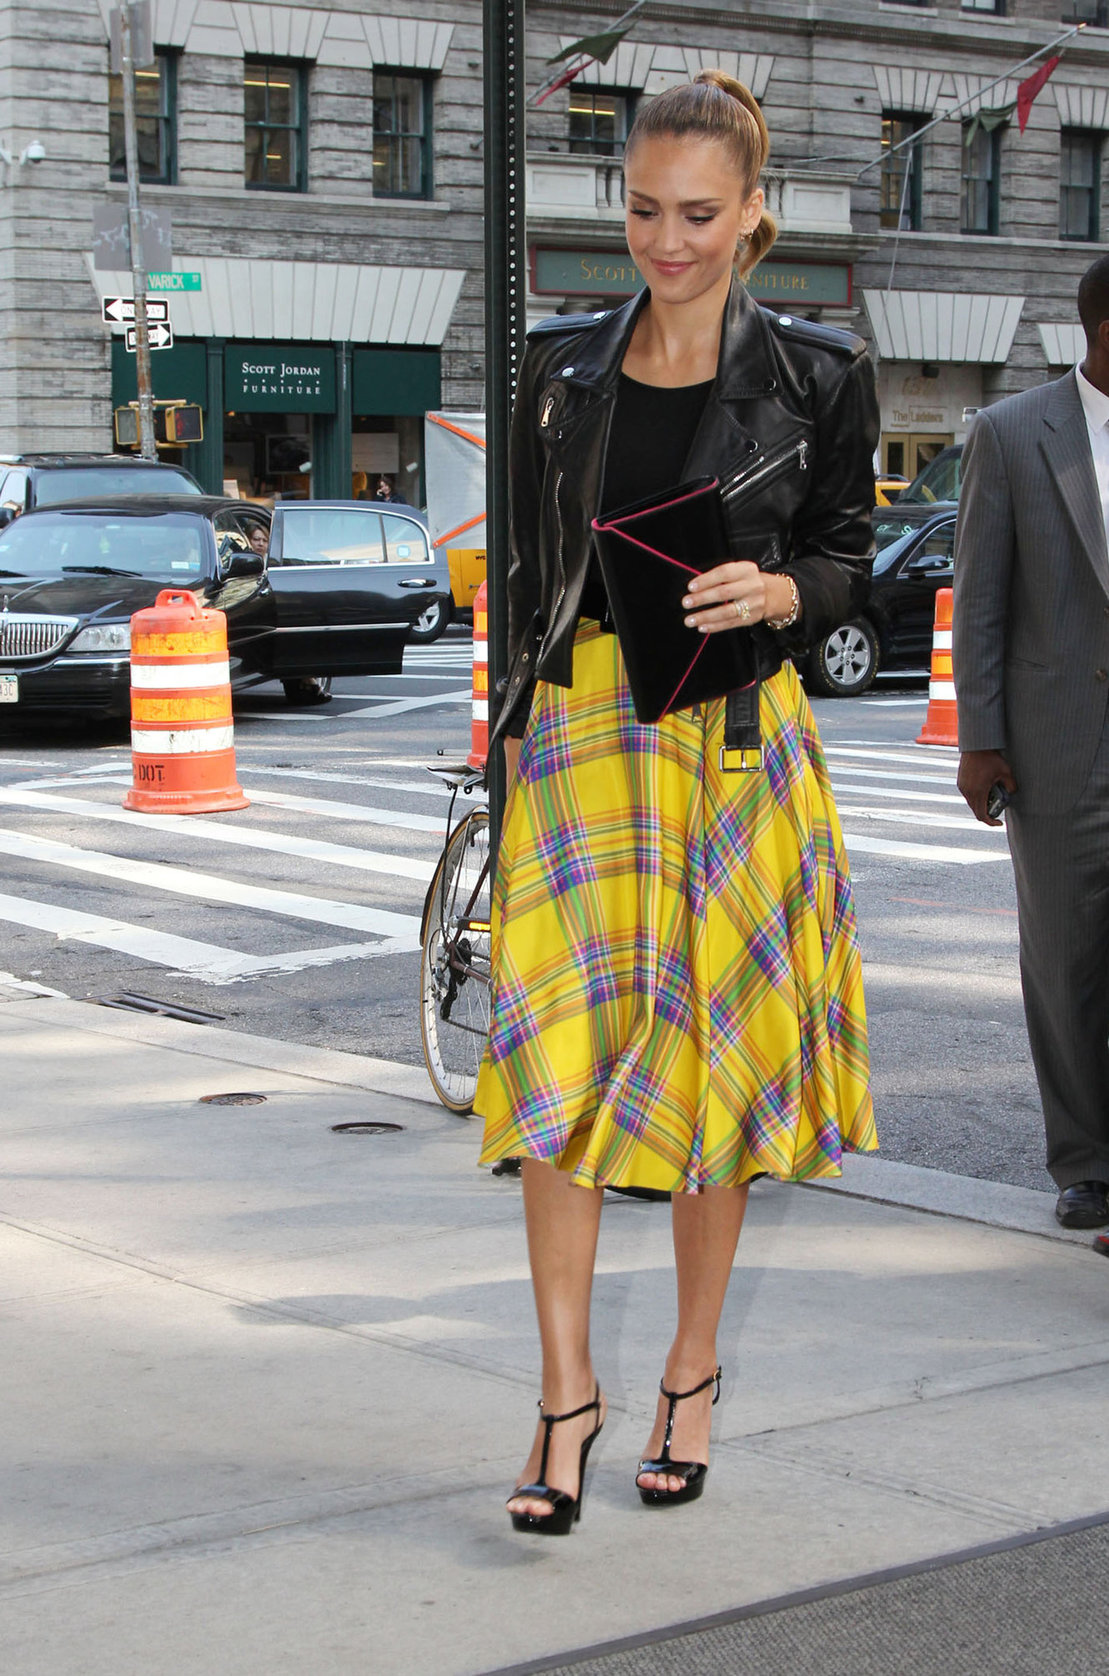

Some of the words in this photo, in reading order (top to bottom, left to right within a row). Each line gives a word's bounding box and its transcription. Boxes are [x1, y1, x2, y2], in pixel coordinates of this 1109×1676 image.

[147, 274, 184, 289] VARICK
[580, 258, 638, 282] SCOTT
[746, 271, 809, 290] NITURE
[242, 362, 276, 375] SCOTT
[280, 363, 320, 378] JORDAN
[243, 385, 320, 395] FURNITURE
[892, 409, 908, 422] The
[138, 764, 164, 782] DOT
